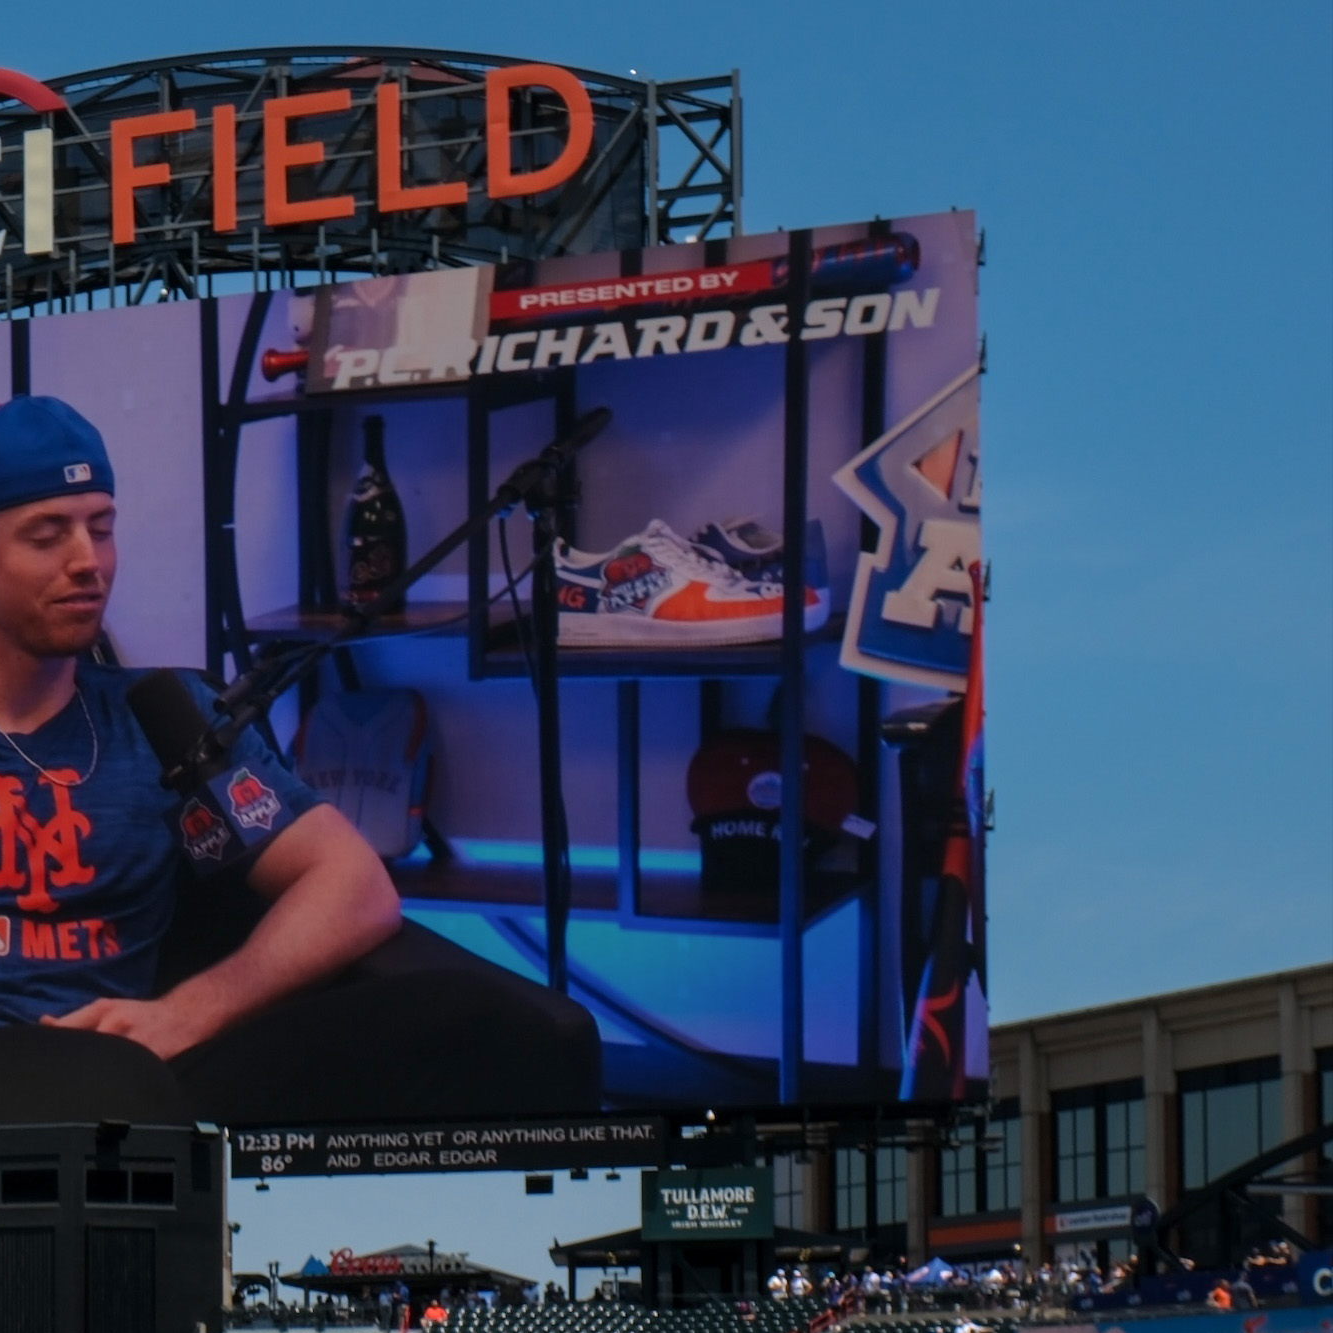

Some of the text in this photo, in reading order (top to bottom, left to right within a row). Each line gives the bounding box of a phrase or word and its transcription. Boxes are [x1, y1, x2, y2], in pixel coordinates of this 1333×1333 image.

[109, 63, 594, 244] FIELD
[519, 271, 740, 310] PRESENTED BY
[440, 308, 735, 381] RICHARD
[740, 305, 789, 346] &
[800, 288, 940, 340] SON
[711, 819, 769, 841] HOME
[21, 919, 121, 960] METS
[237, 1124, 655, 1152] 12:33 PM ANYTHING YET OR ANYTHING LIKE THAT.
[261, 1154, 293, 1173] 86°
[326, 1152, 361, 1169] AND
[439, 1148, 498, 1165] EDGAR
[660, 1186, 755, 1204] TULLAMORE
